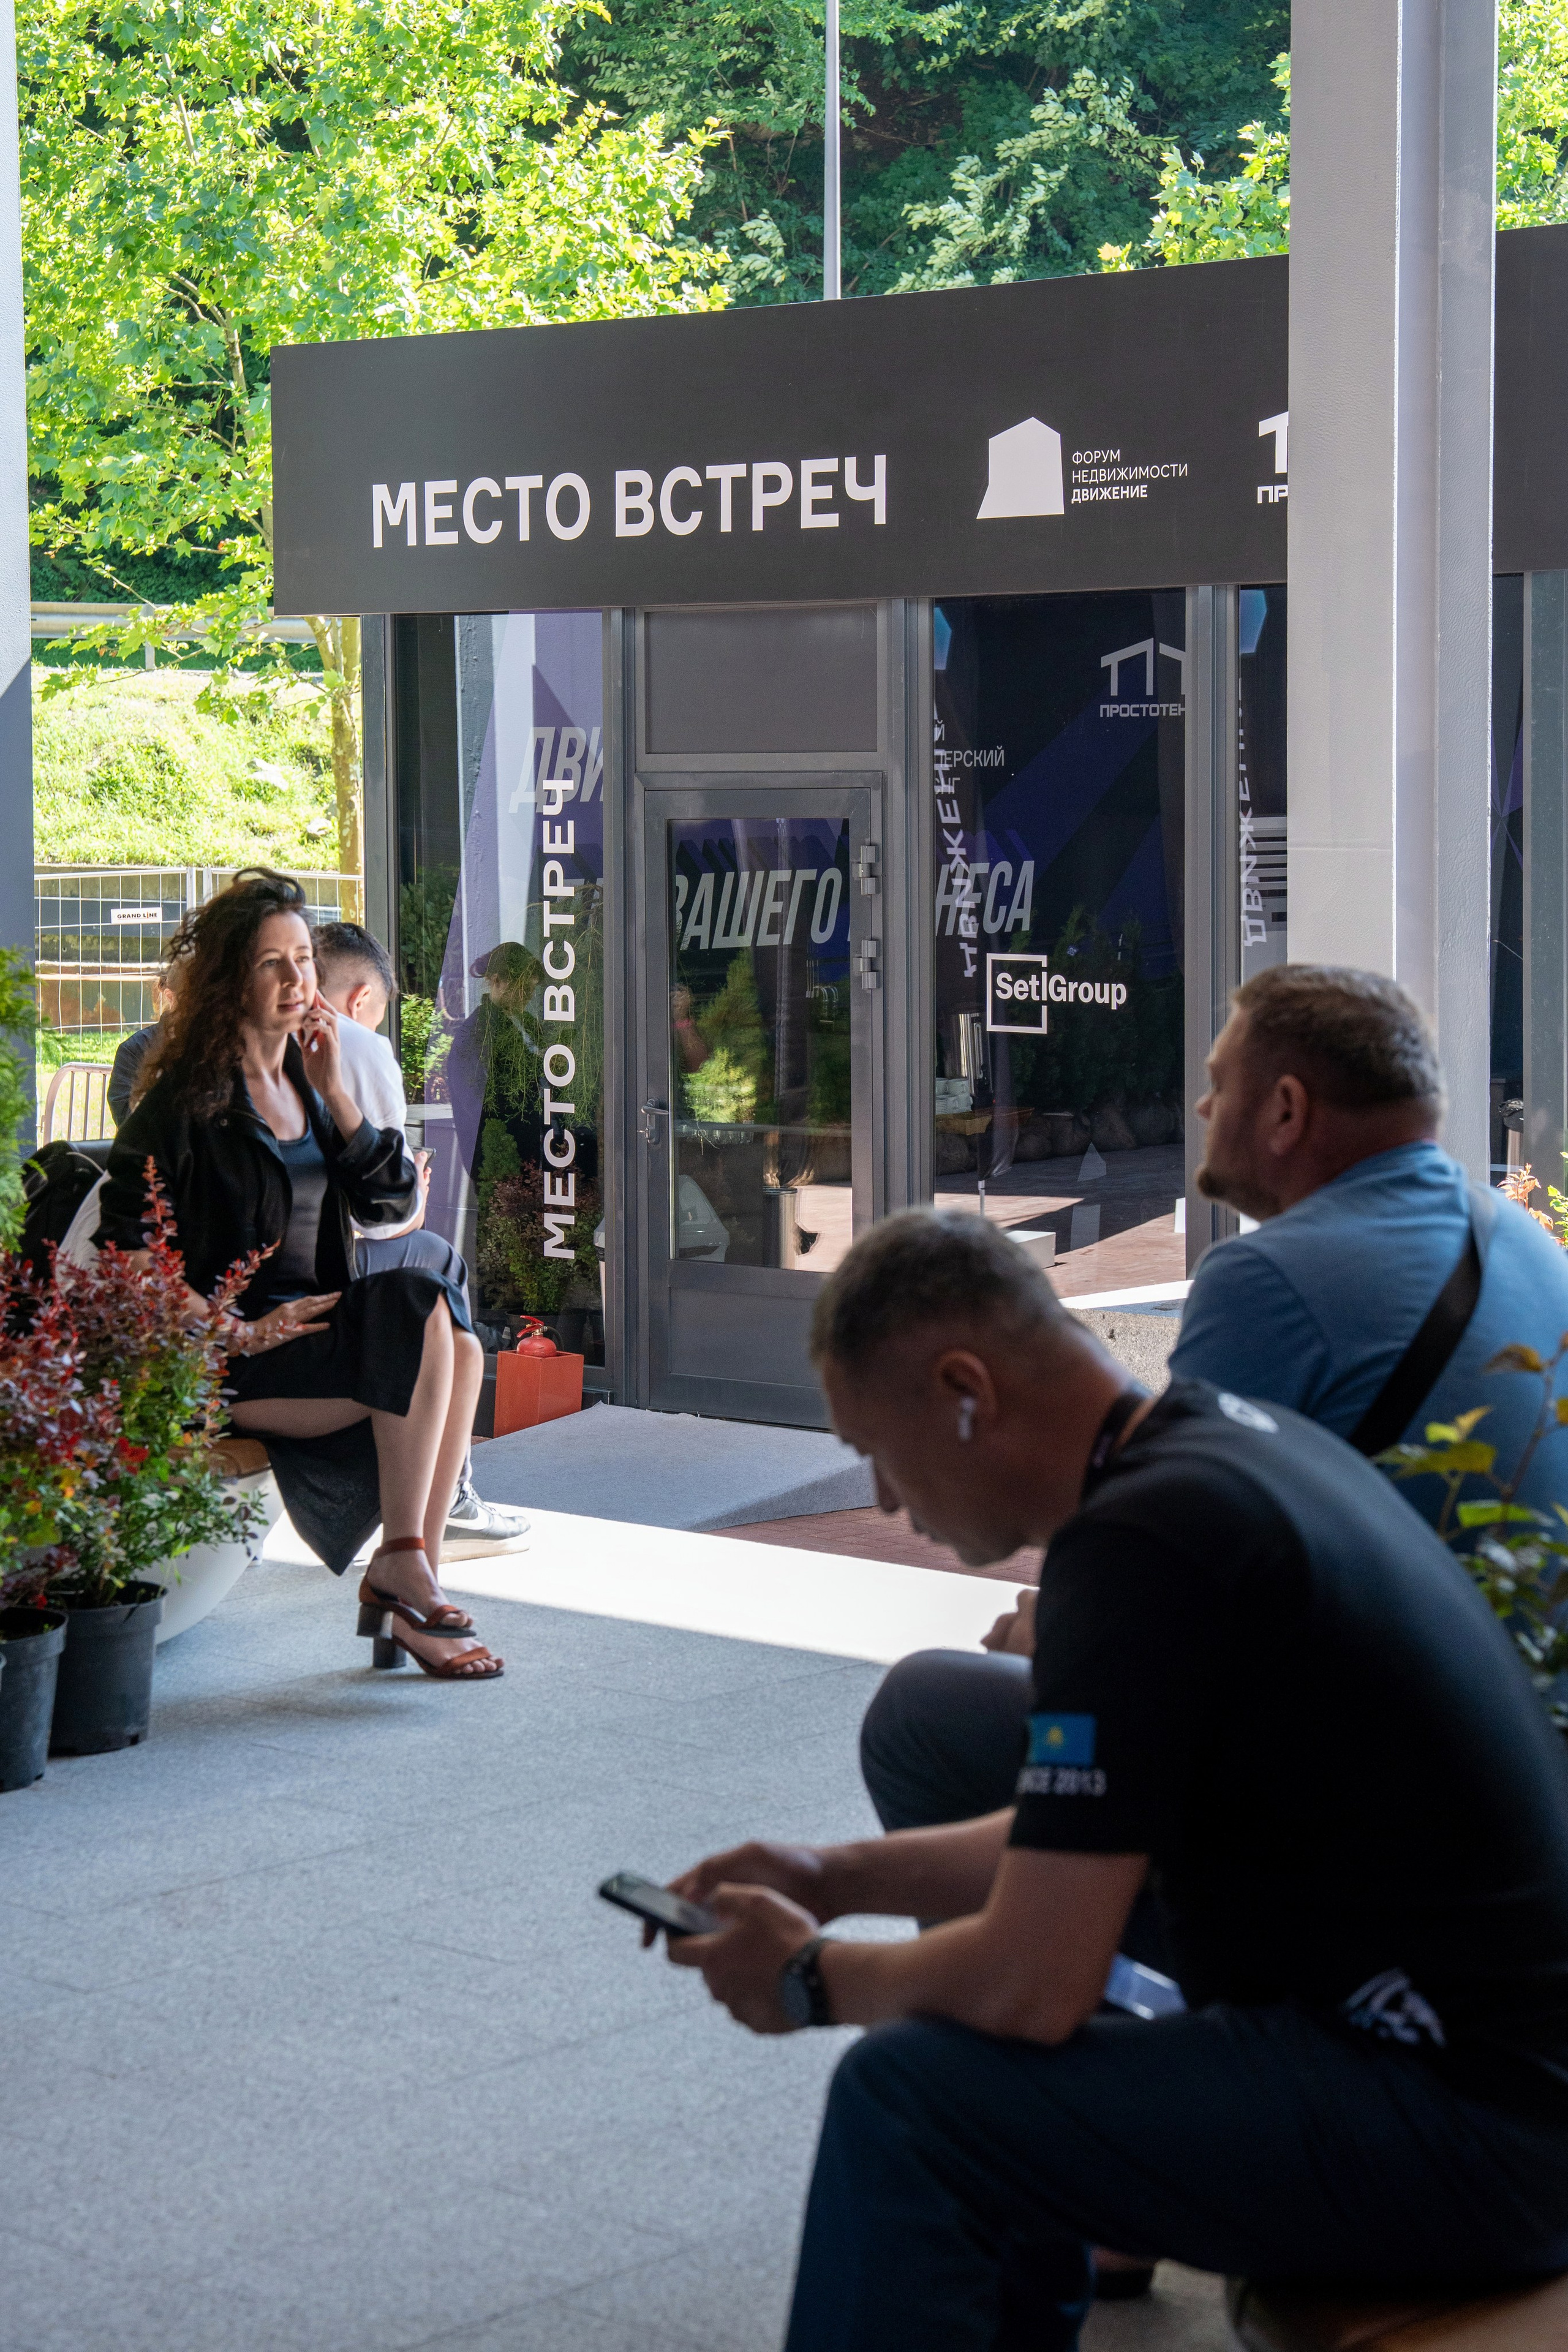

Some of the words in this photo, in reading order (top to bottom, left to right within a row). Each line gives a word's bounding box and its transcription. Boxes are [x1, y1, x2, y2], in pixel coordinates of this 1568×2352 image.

[1072, 449, 1120, 465] ФОРУМ
[1072, 464, 1188, 484] НЕДВИЖИМОСТИ
[372, 472, 590, 548] МЕСТО
[615, 454, 886, 537] ВСТРЕЧ
[1071, 484, 1148, 503] ДВИЖЕНИЕ
[543, 780, 575, 1022] ВСТРЕЧ
[543, 1044, 575, 1259] МЕСТО
